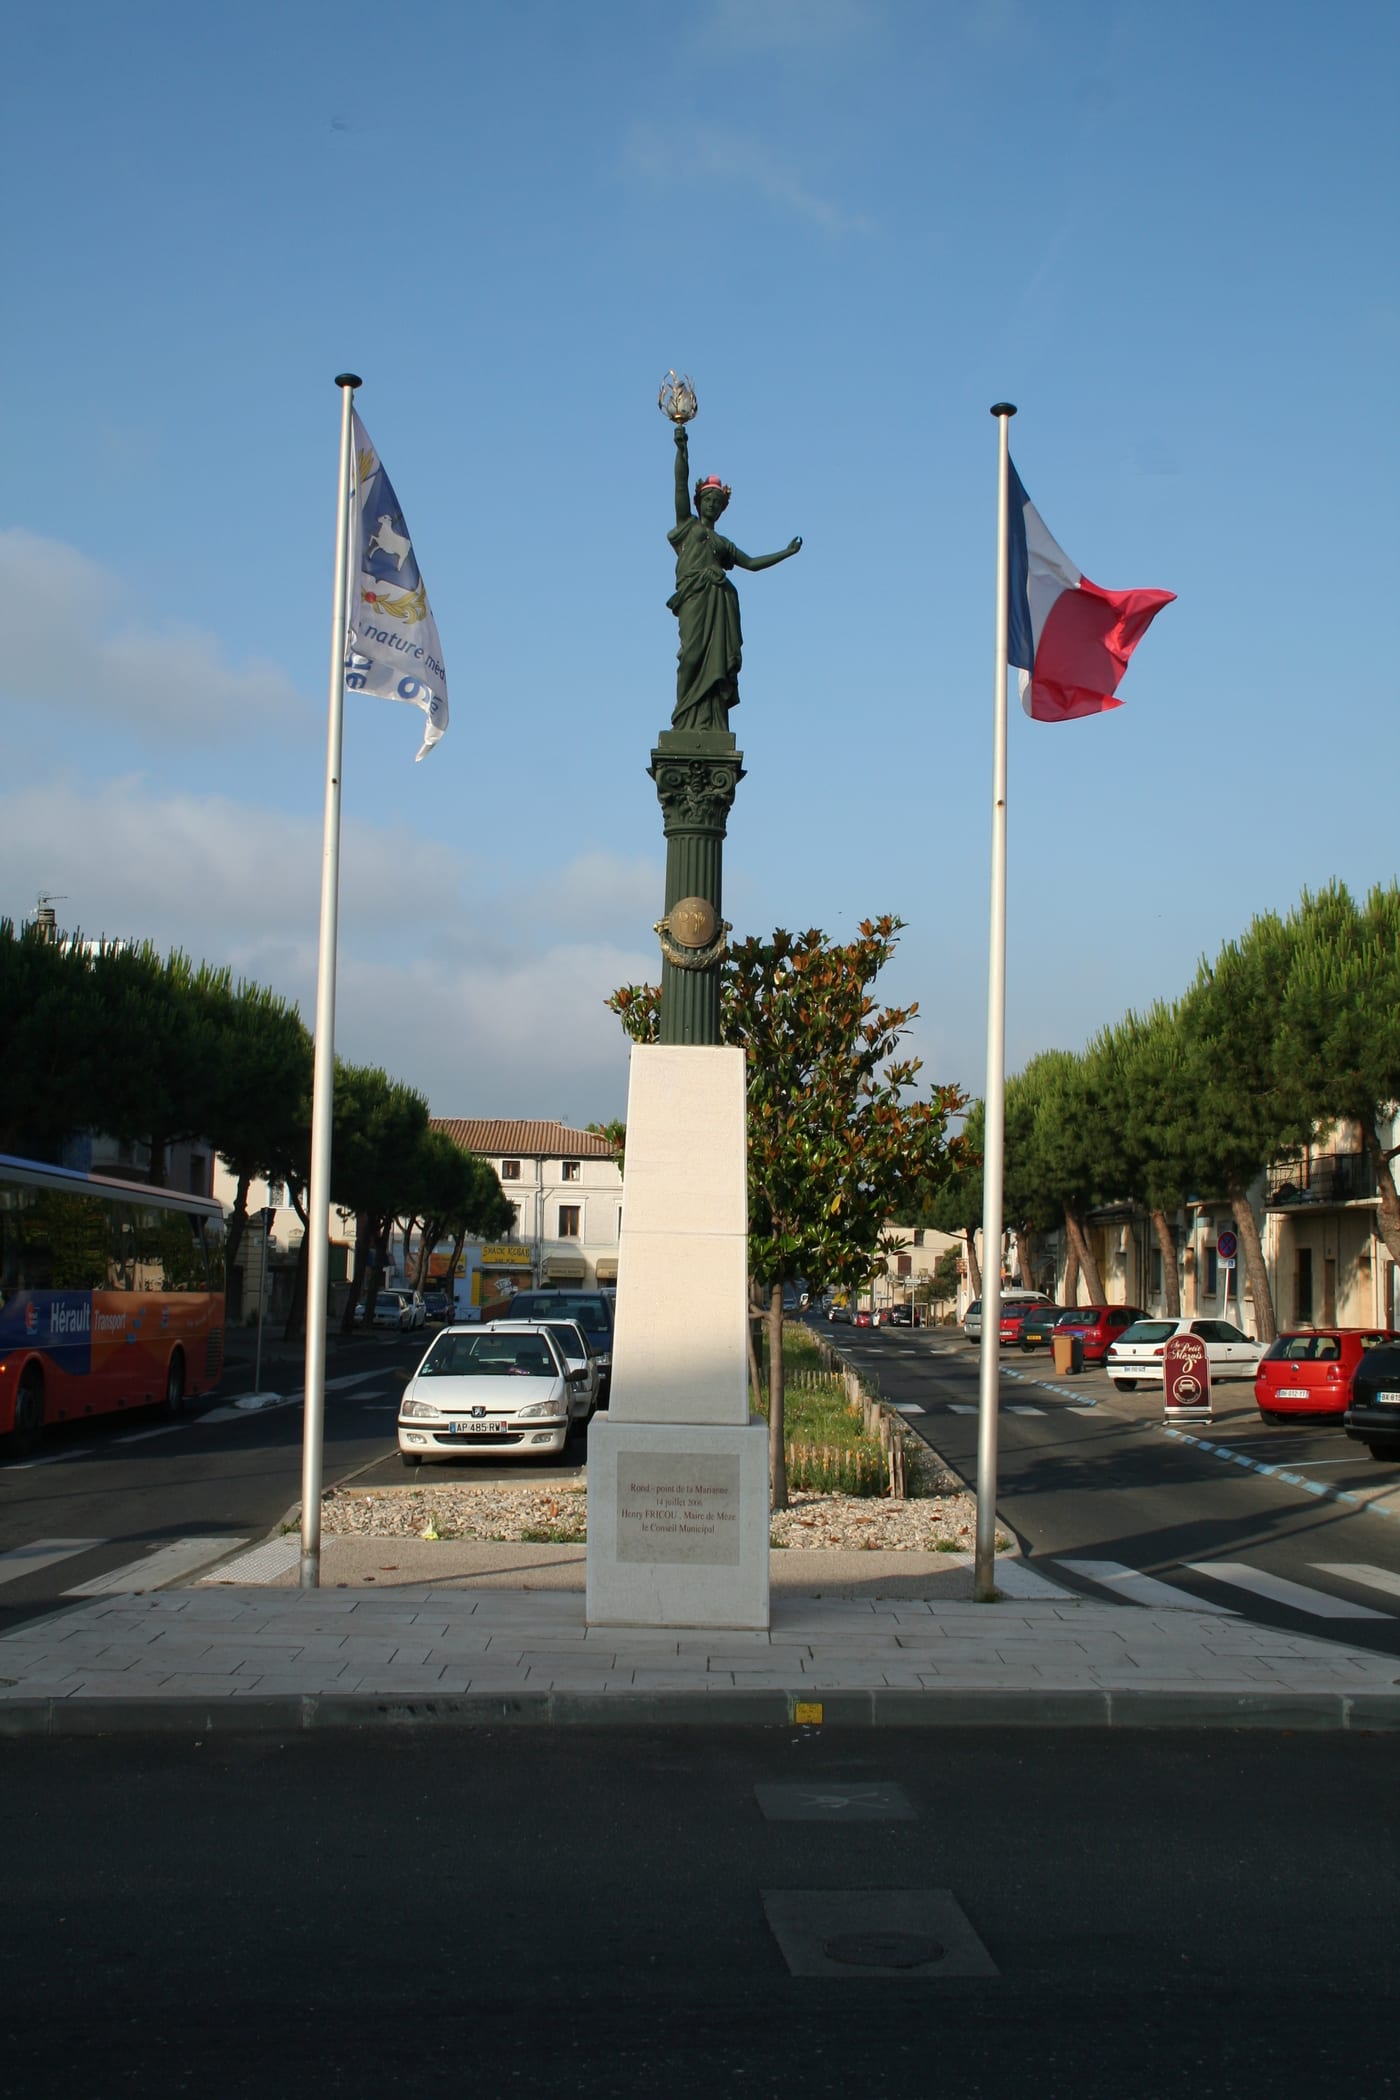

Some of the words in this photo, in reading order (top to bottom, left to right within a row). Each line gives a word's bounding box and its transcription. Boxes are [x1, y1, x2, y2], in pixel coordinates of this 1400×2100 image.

[363, 625, 424, 659] nature
[50, 1301, 91, 1334] Hérault
[94, 1309, 127, 1334] Transport
[630, 1483, 650, 1493] Rond
[656, 1485, 675, 1494] point
[676, 1485, 685, 1493] de
[686, 1485, 693, 1493] la
[695, 1486, 729, 1495] Marianne
[656, 1498, 664, 1506] 14
[665, 1498, 686, 1508] juillet
[621, 1509, 643, 1520] Henry
[684, 1511, 704, 1520] Maire
[706, 1512, 715, 1520] de
[650, 1523, 677, 1532] Conseil
[680, 1524, 715, 1534] Municipal
